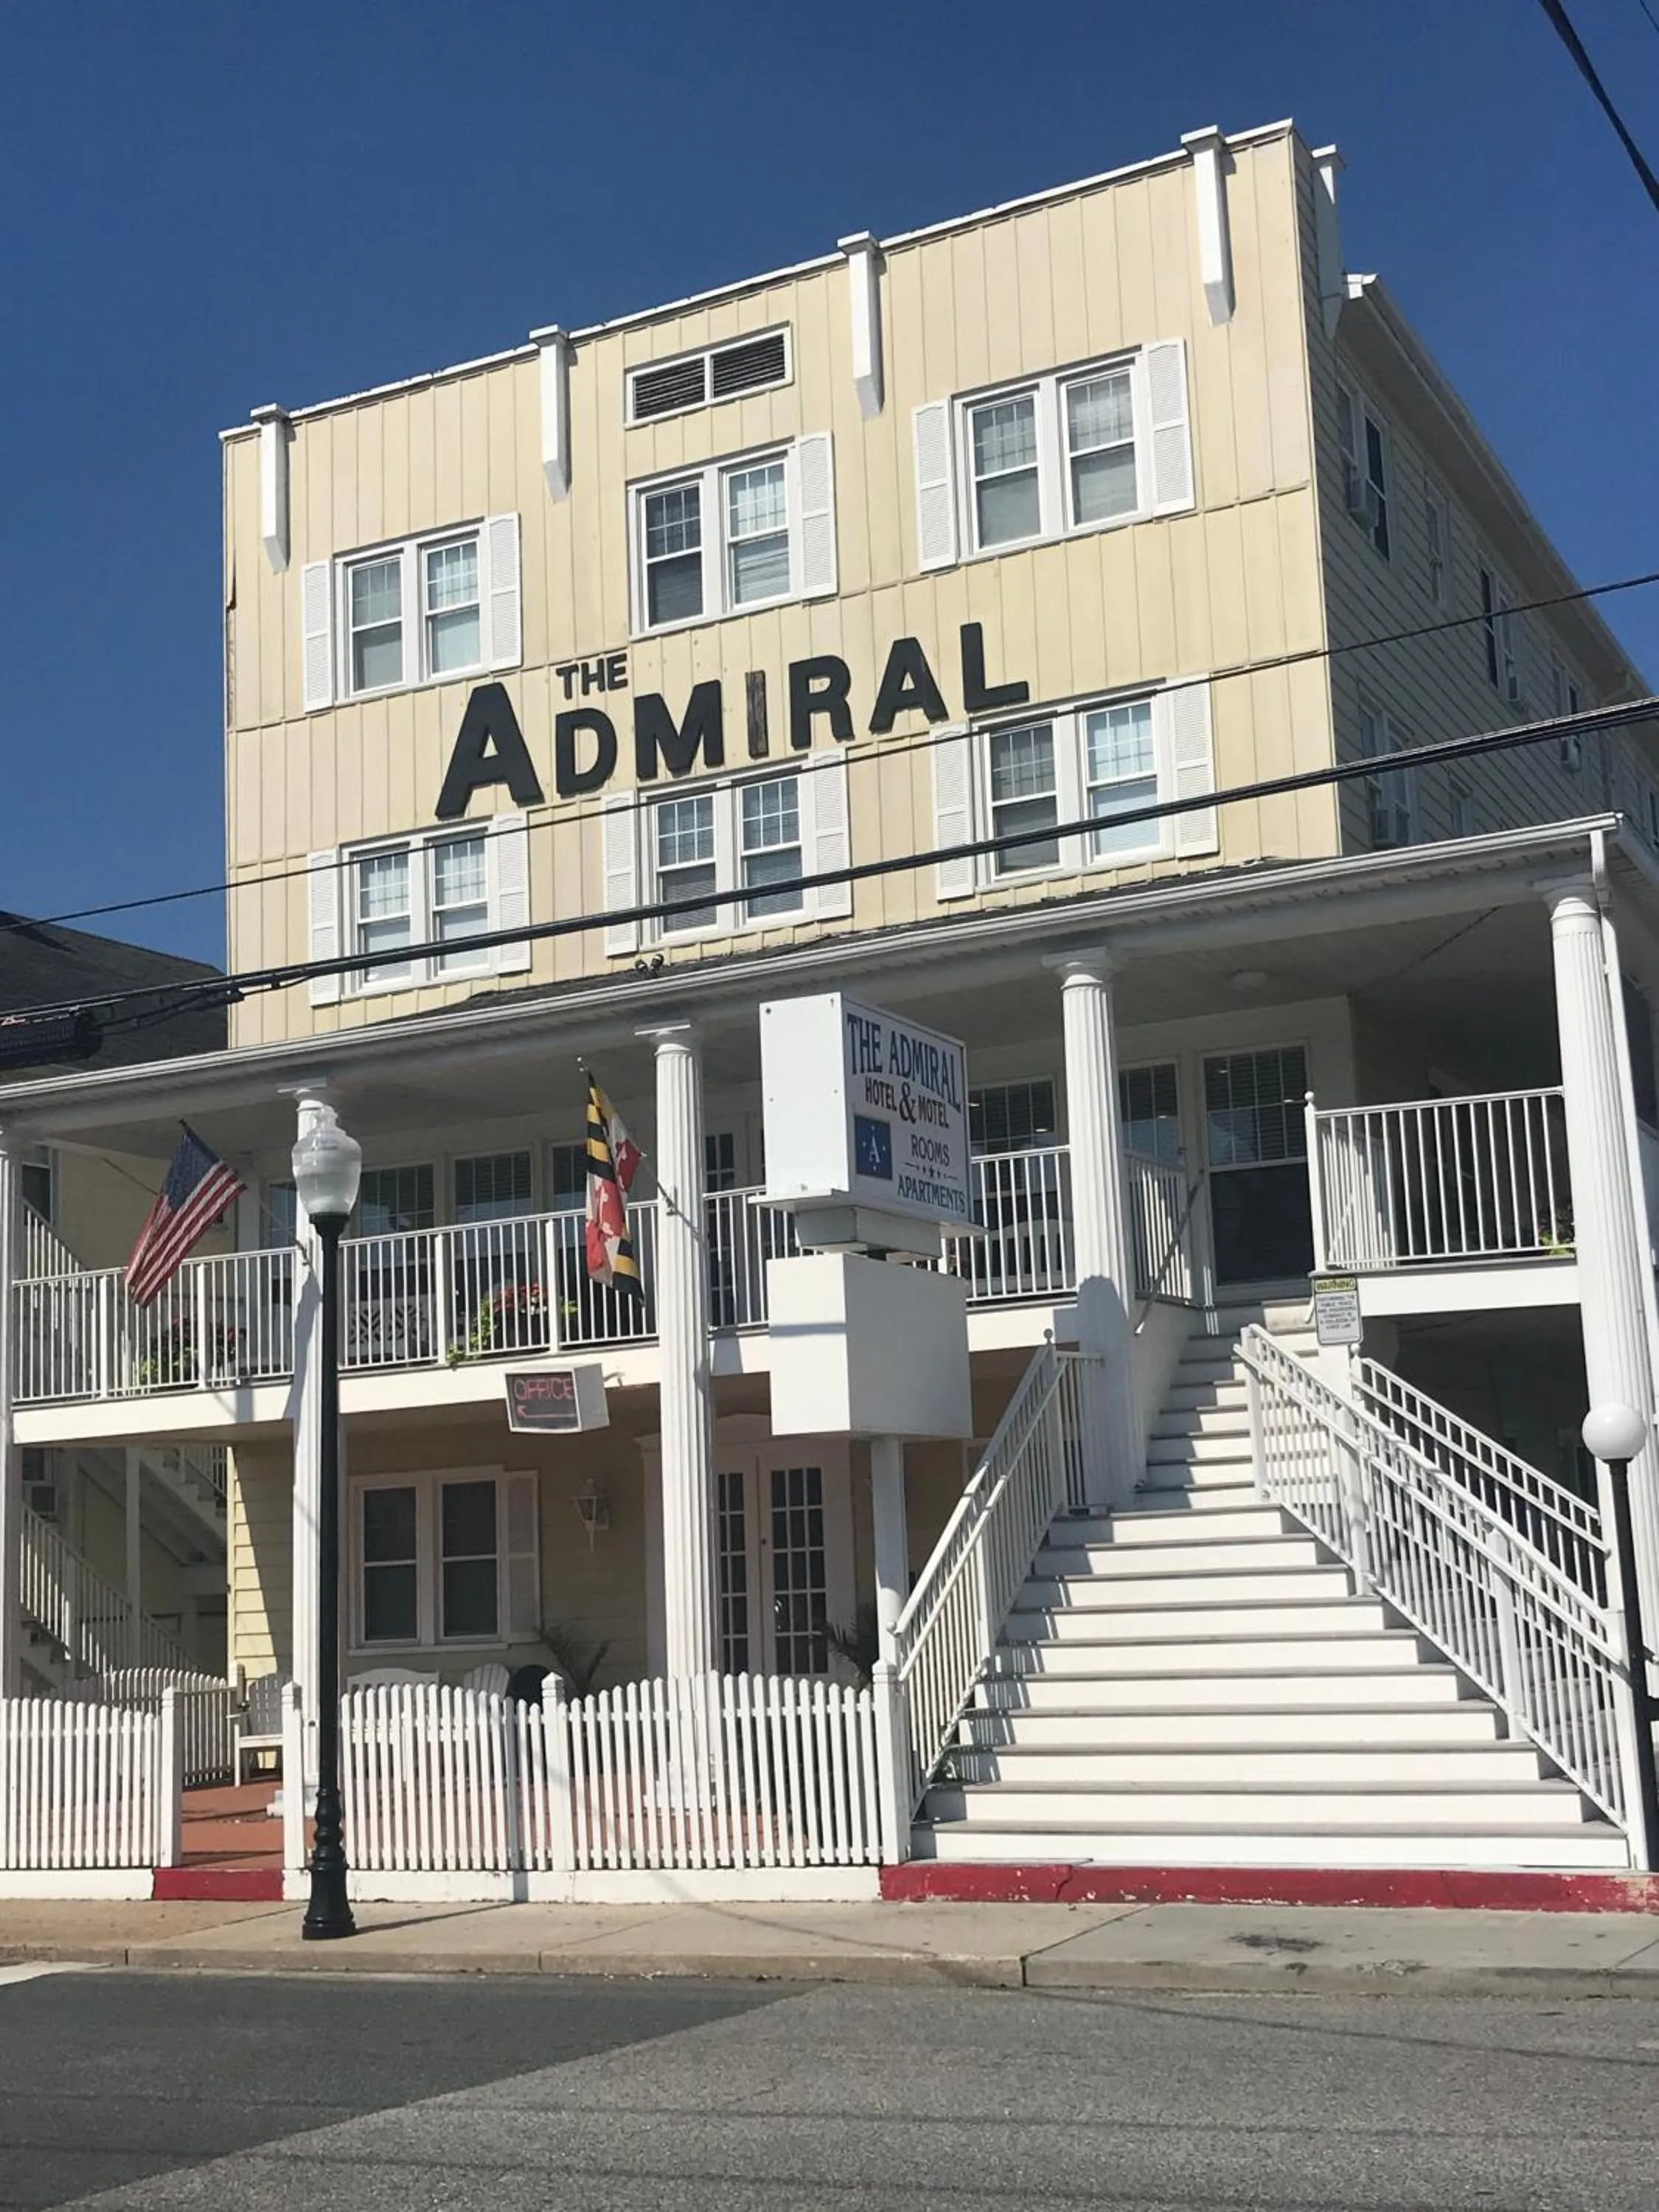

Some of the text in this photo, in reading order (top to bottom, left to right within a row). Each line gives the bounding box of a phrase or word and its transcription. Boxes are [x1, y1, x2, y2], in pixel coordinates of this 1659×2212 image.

[555, 653, 627, 700] THE
[435, 622, 1029, 818] ADMIRAL
[846, 1013, 961, 1113] THE ADMIRAL
[865, 1077, 950, 1129] HOTEL & MOTEL
[869, 1135, 880, 1164] A
[911, 1134, 950, 1166] ROOMS
[897, 1175, 966, 1214] APARTMENTS
[514, 1377, 574, 1400] OFFICE
